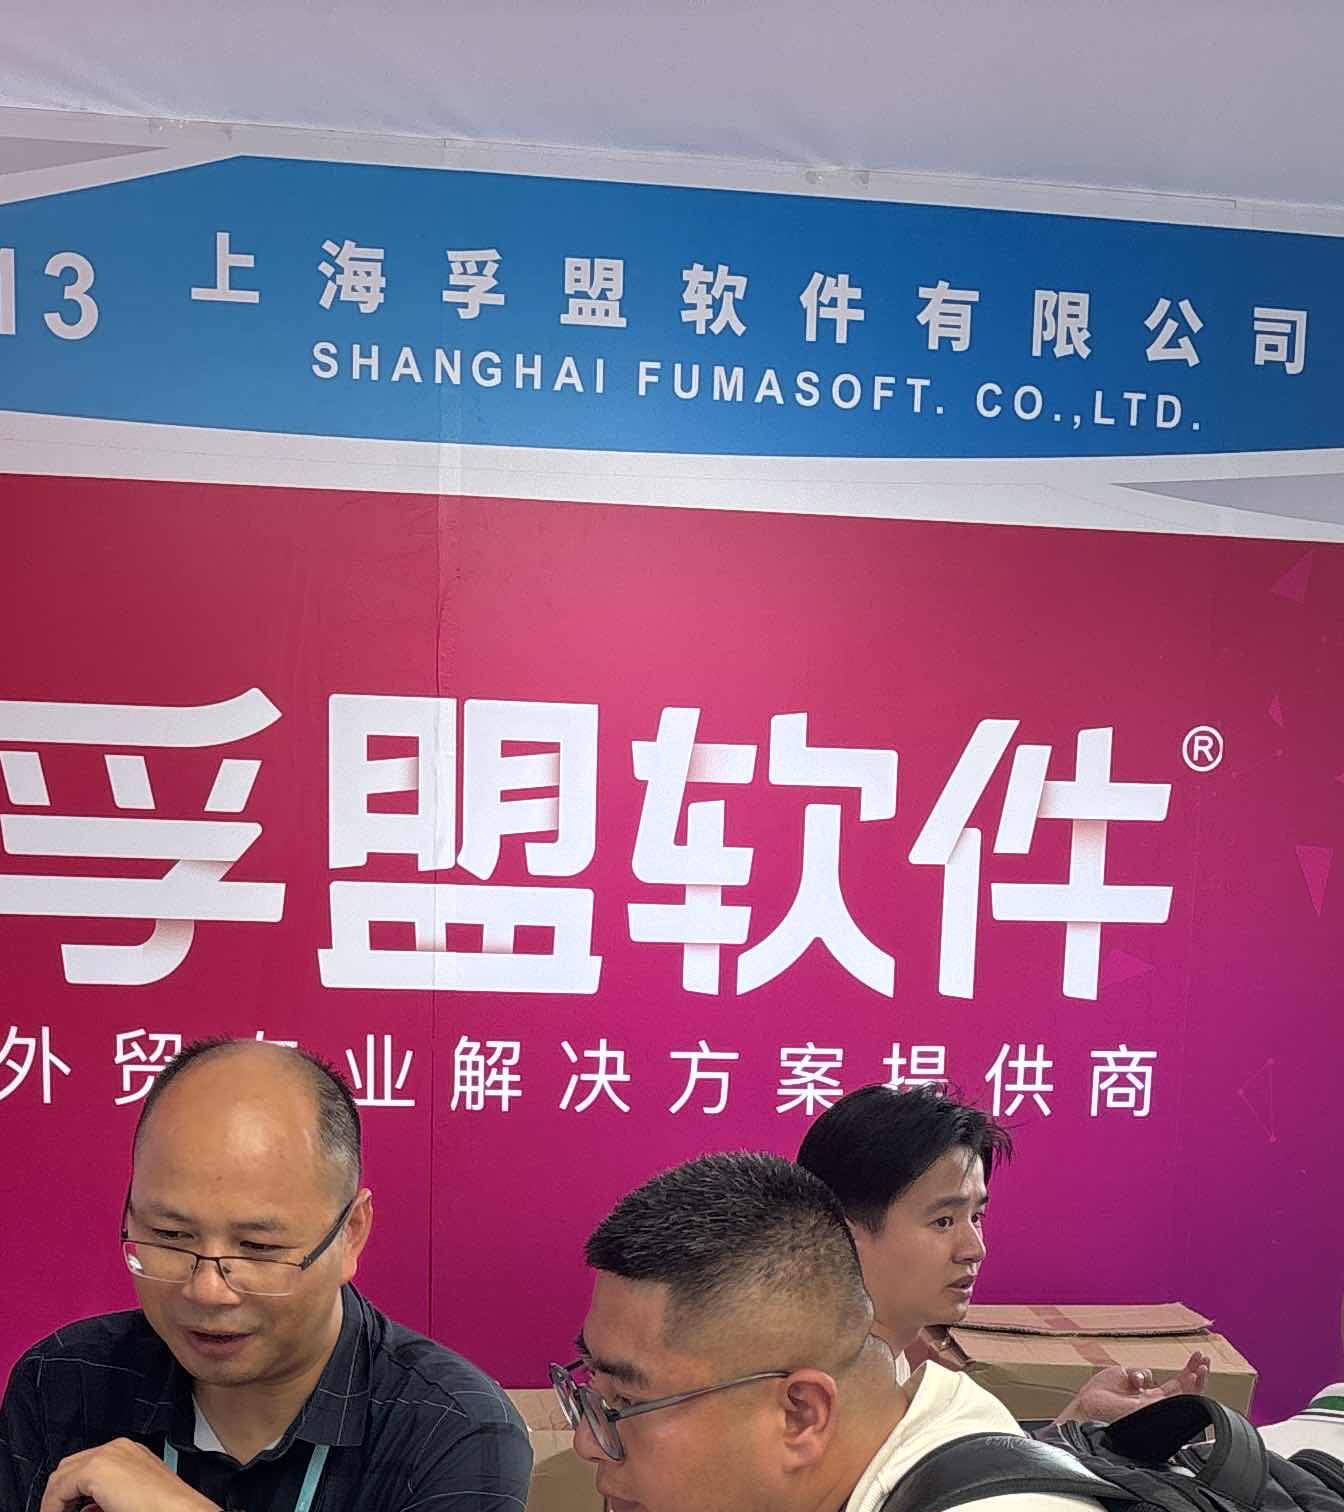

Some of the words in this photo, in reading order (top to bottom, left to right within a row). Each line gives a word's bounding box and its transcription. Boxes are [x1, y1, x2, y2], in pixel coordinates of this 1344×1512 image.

[191, 231, 1308, 376] 上海孚盟软件有限公司
[311, 341, 605, 395] SHANGHAI
[637, 360, 945, 416] FUMASOFT.
[975, 382, 1202, 432] CO.,LTD.
